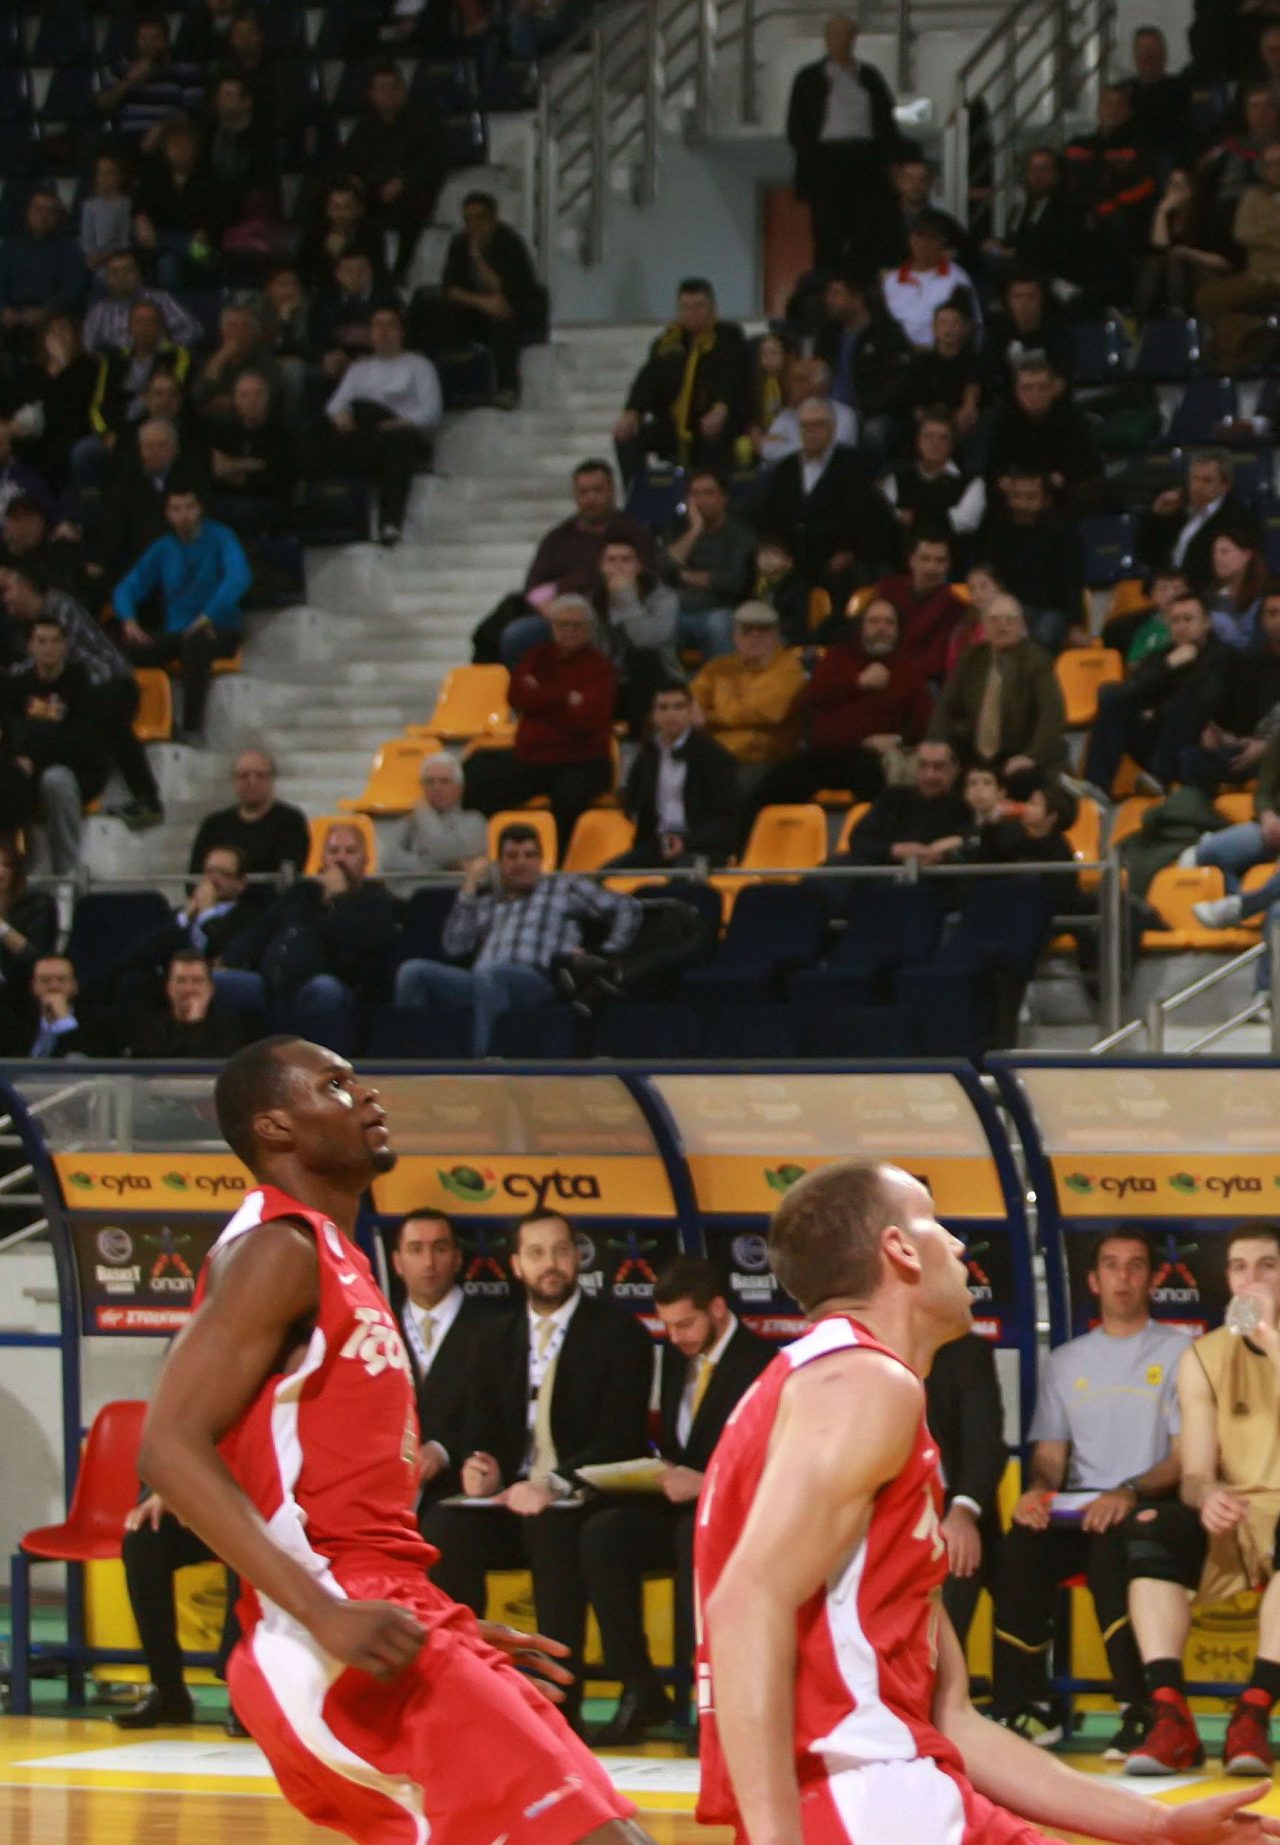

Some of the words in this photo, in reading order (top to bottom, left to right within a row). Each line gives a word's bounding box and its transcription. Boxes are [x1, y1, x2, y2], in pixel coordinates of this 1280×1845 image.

[101, 1173, 151, 1196] cyta
[195, 1174, 247, 1196] cyta
[503, 1169, 602, 1210] cyta
[1101, 1175, 1157, 1198] cyta
[1206, 1175, 1263, 1198] cyta
